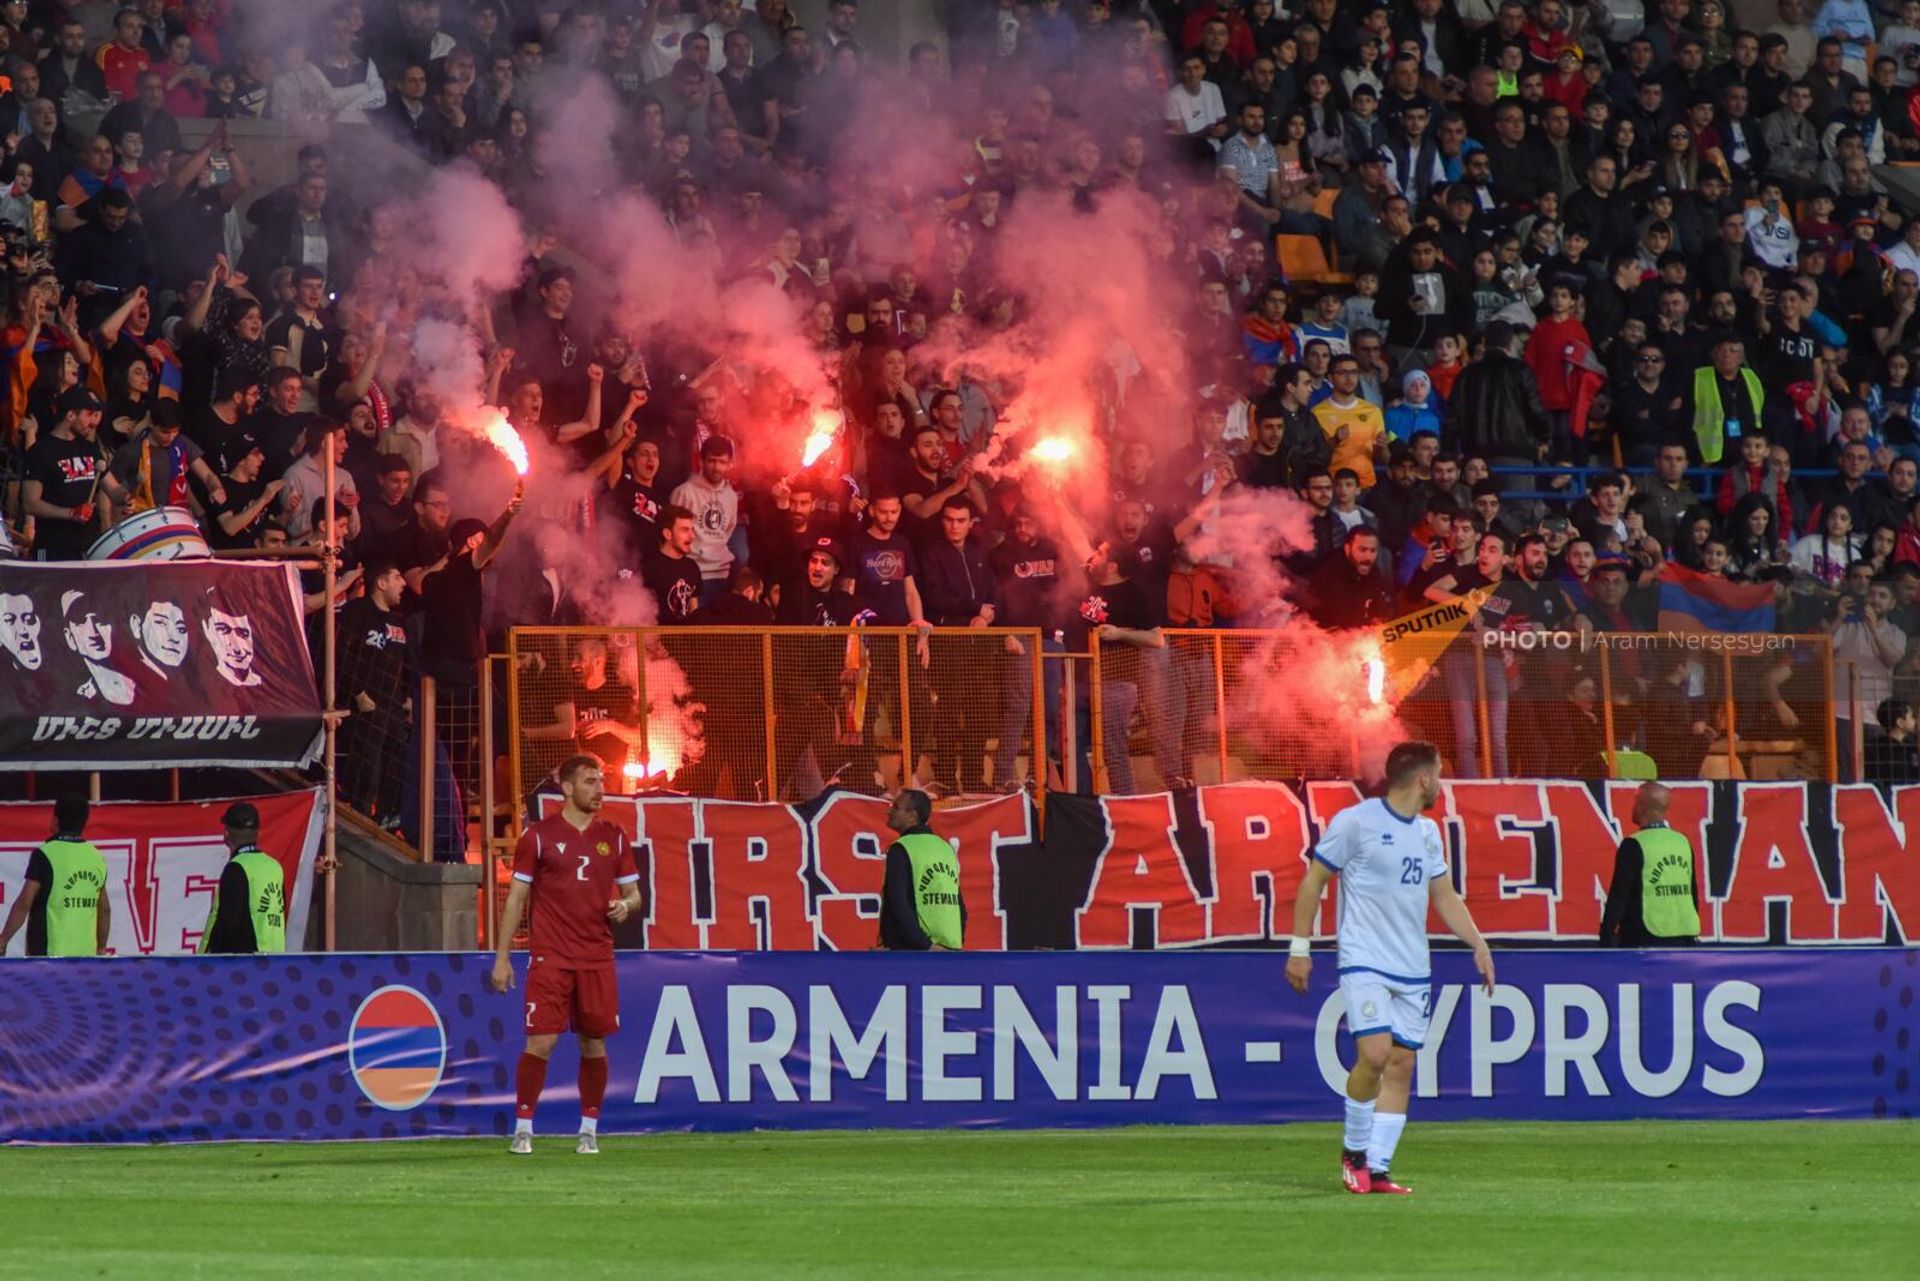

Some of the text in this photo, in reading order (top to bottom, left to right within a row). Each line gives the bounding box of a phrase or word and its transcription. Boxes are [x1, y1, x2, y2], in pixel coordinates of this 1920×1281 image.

[576, 856, 590, 881] 2
[1400, 856, 1423, 886] 25
[922, 892, 960, 905] STEWAR
[1654, 884, 1690, 897] STEWAR
[634, 983, 1218, 1104] ARMENIA
